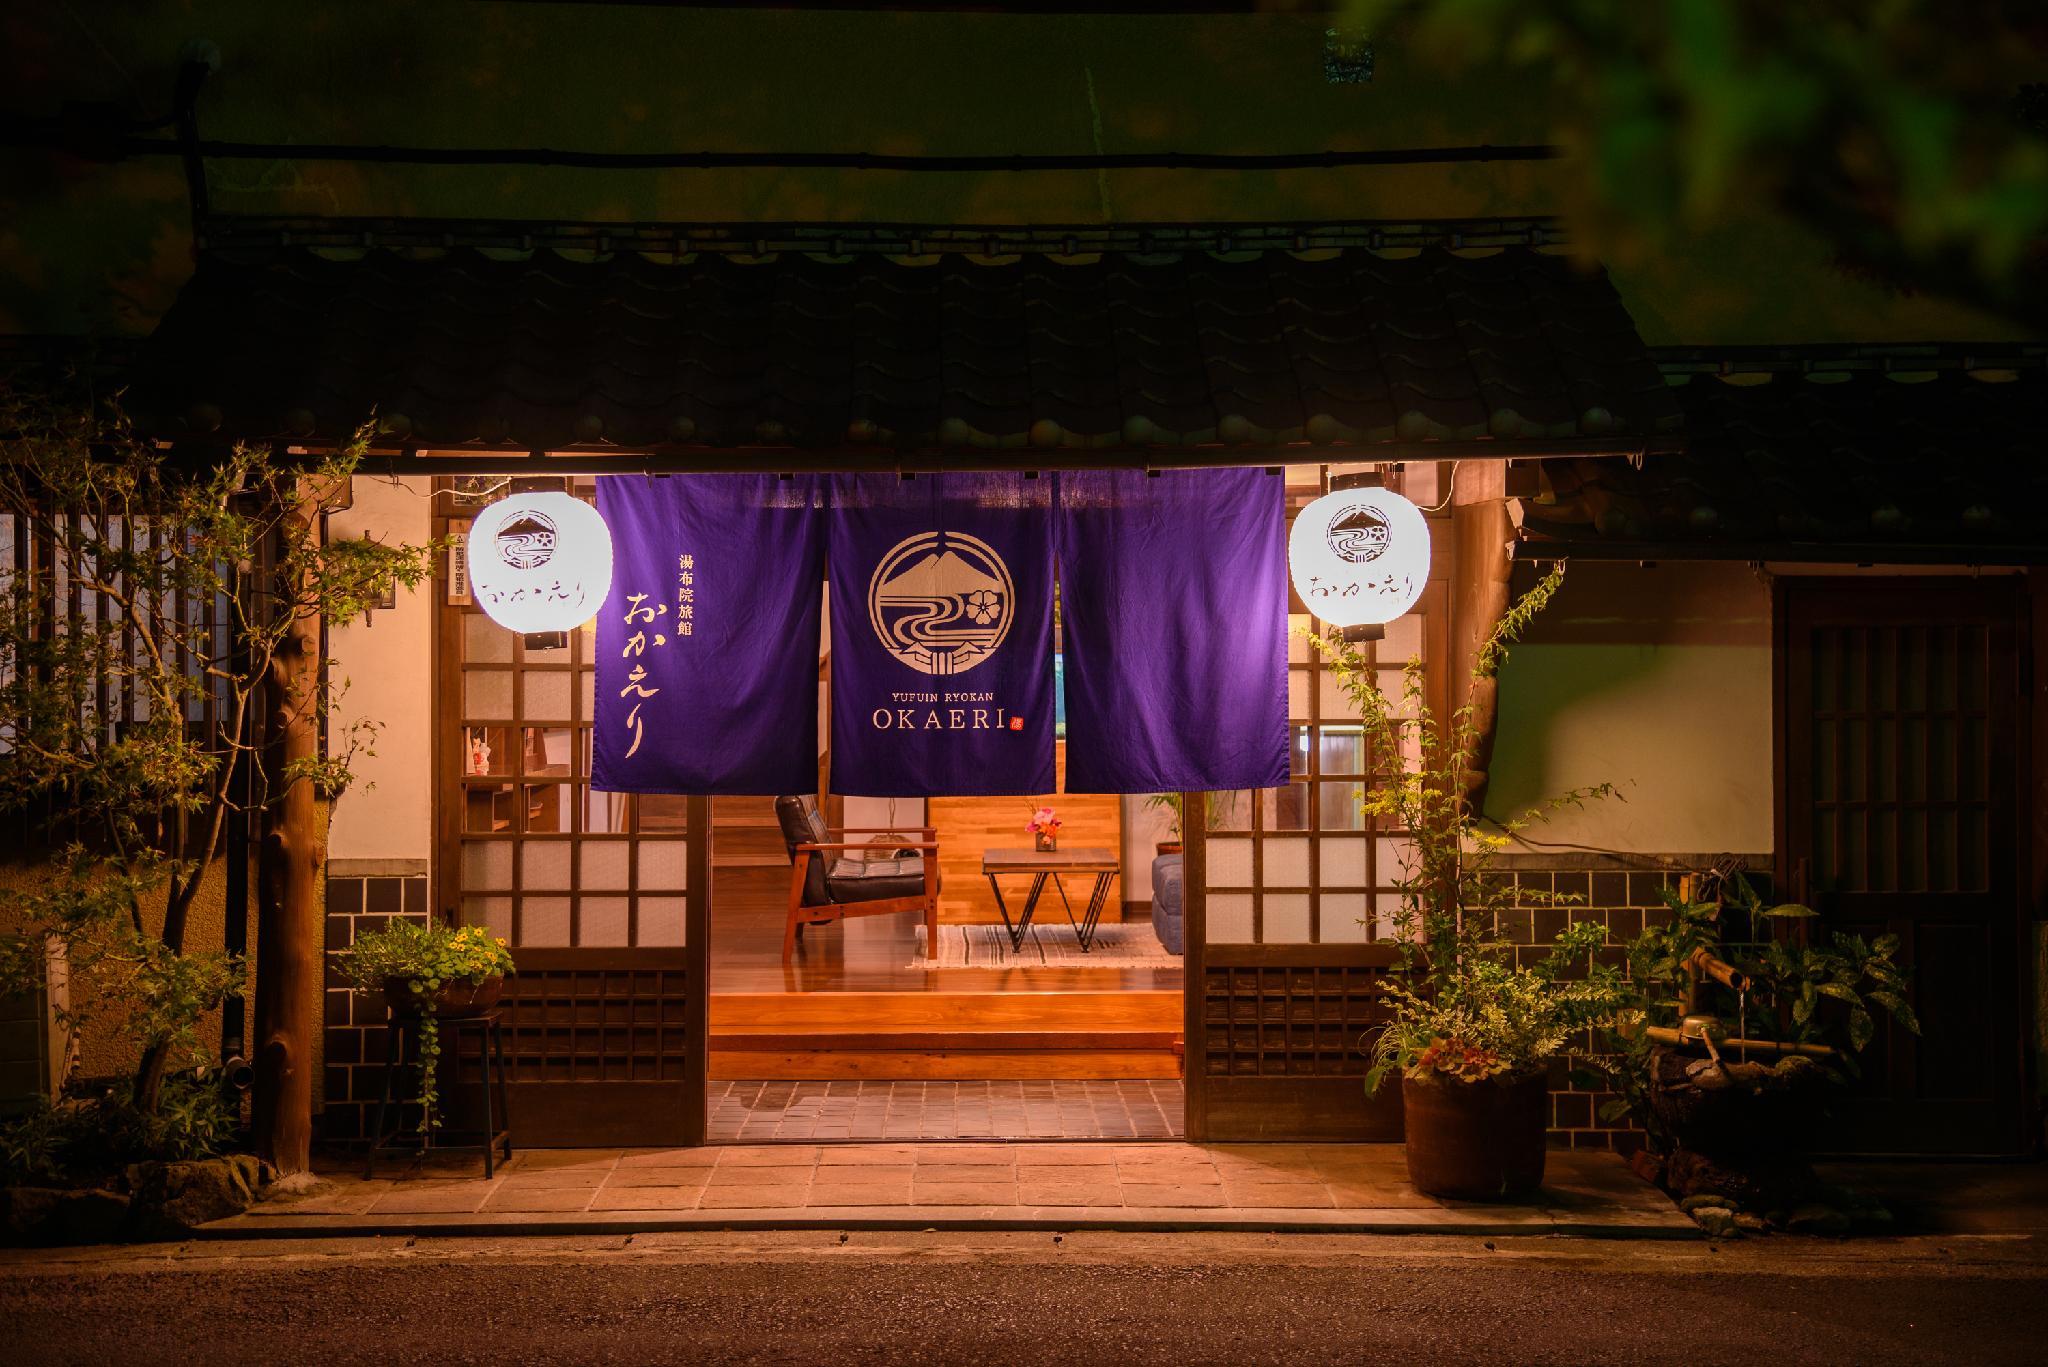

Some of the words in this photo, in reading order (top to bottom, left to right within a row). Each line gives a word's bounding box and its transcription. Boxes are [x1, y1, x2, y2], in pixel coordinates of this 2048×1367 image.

[677, 554, 695, 636] 湯布院旅館
[1309, 573, 1414, 600] おかえり
[620, 591, 668, 759] おかえり
[891, 692, 938, 703] YUFUIN
[944, 692, 994, 702] RYOKAN
[872, 708, 1005, 729] OKAERI
